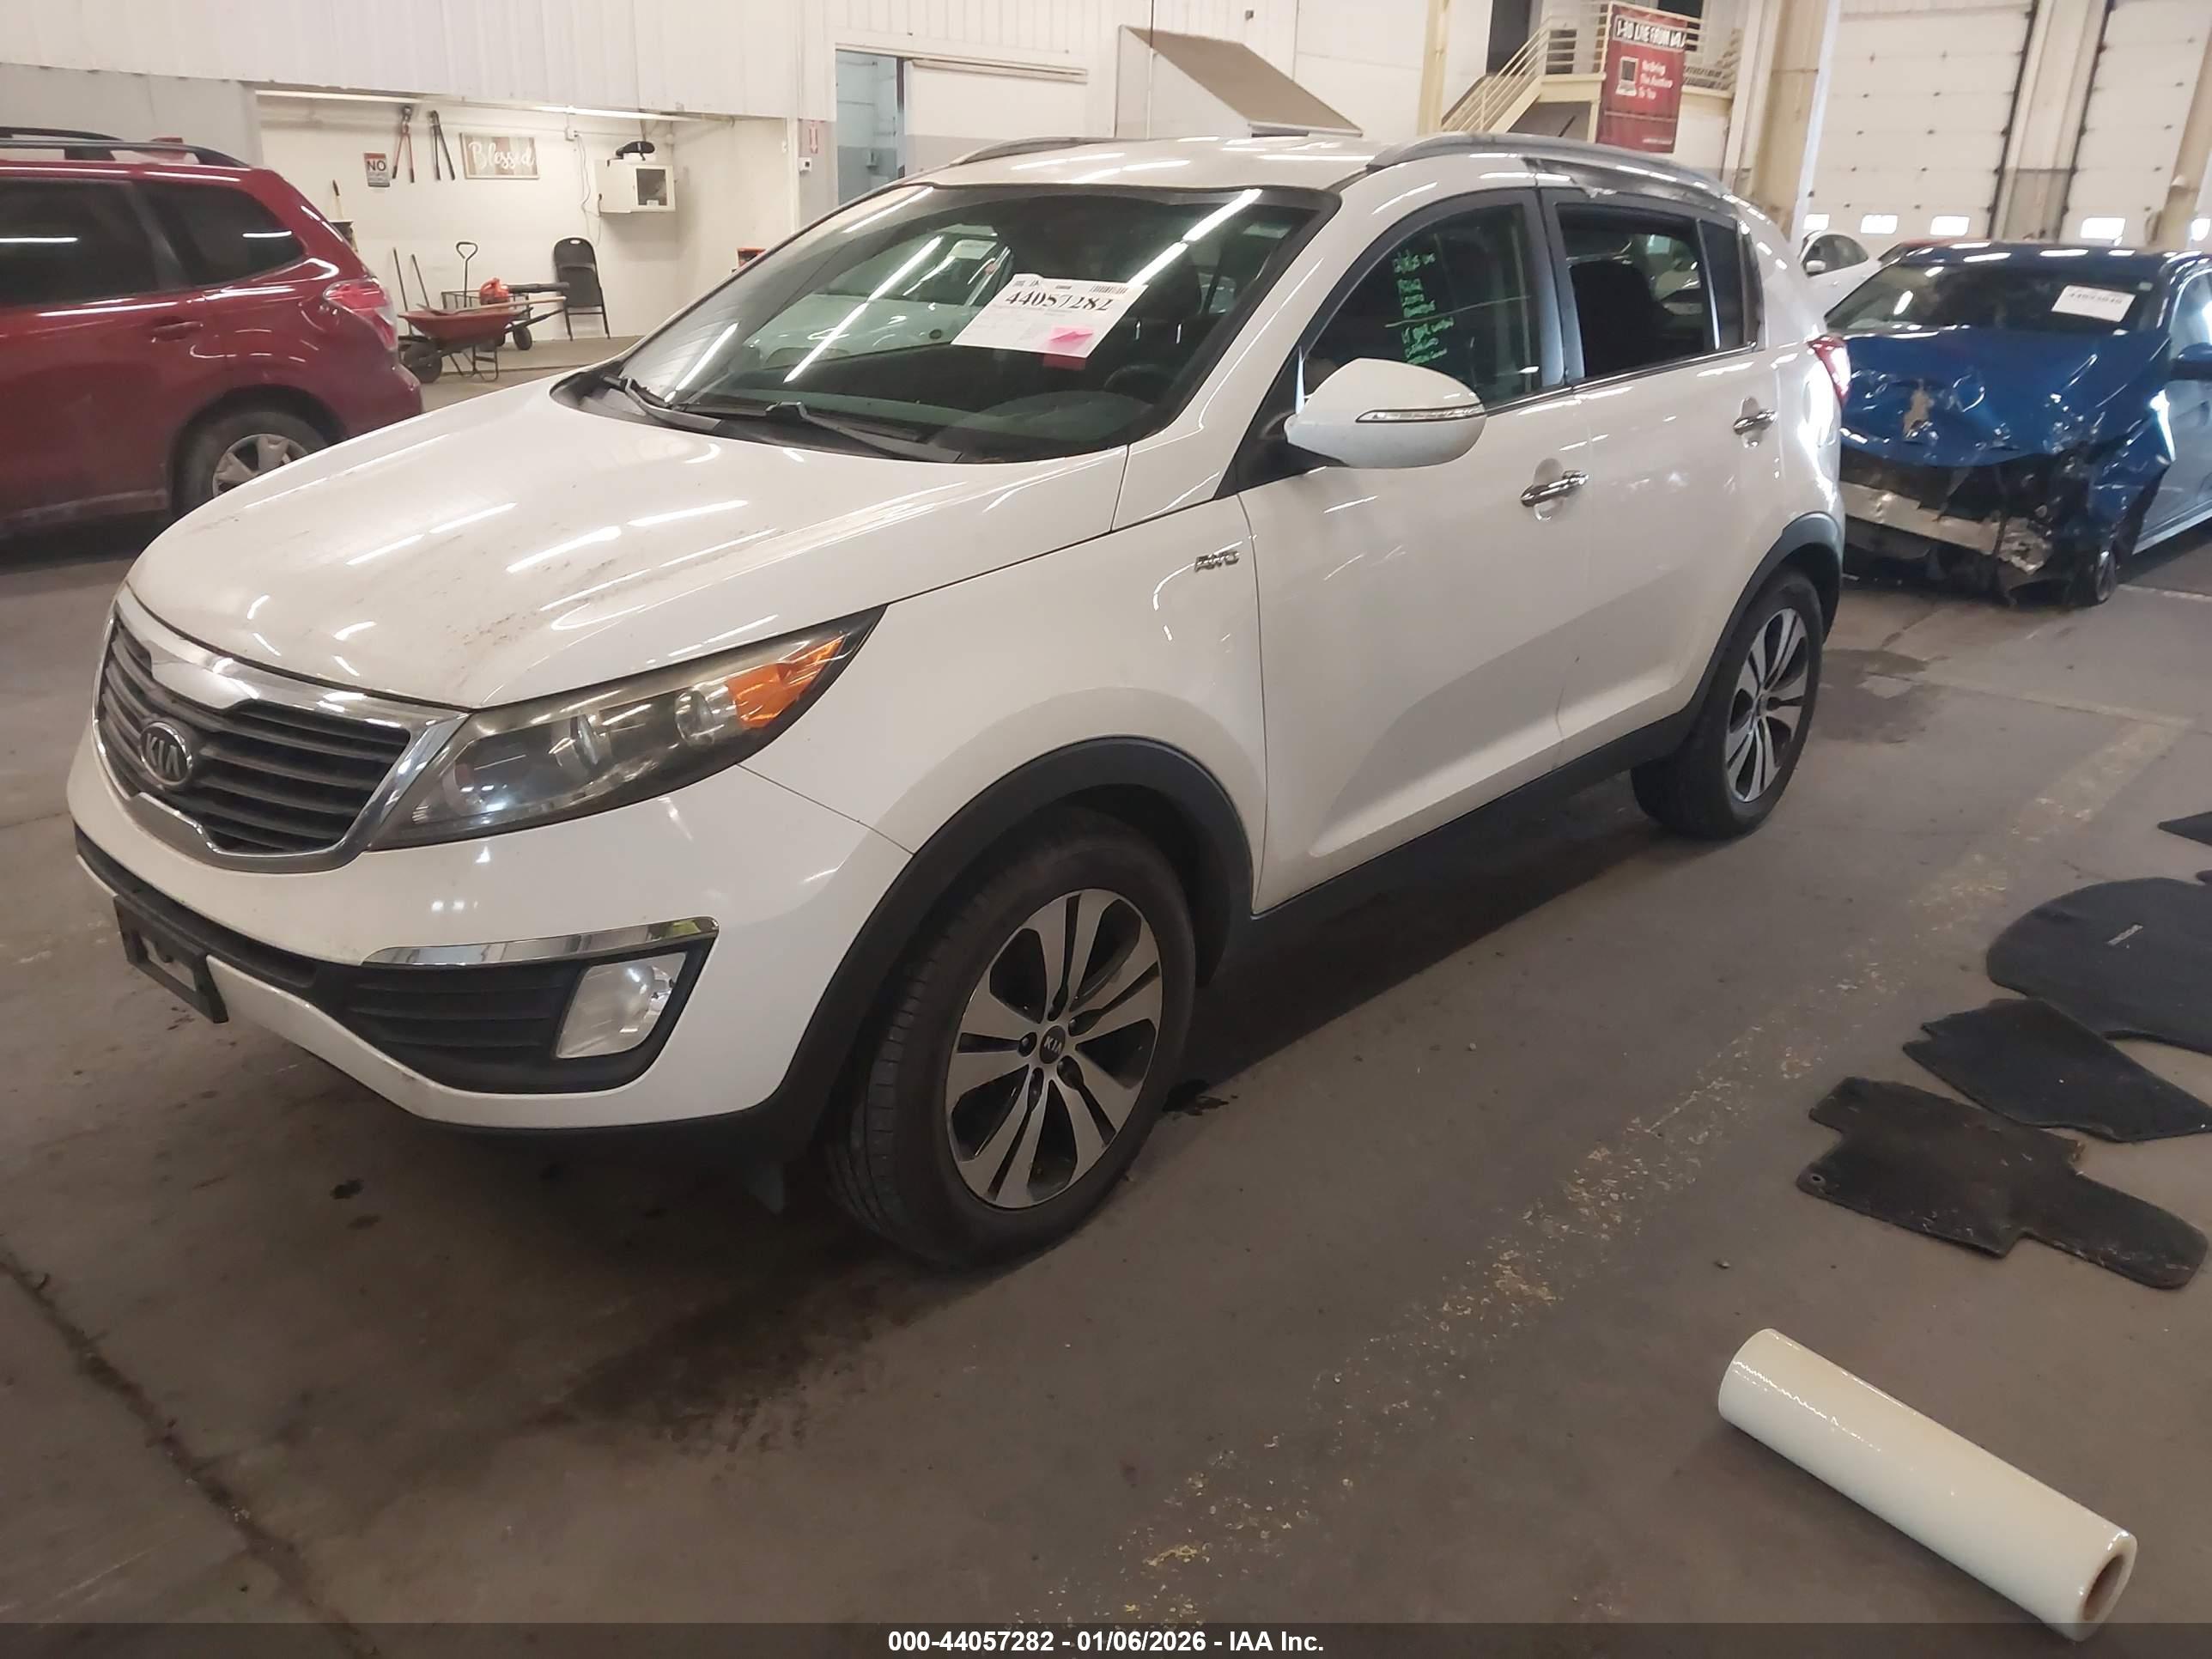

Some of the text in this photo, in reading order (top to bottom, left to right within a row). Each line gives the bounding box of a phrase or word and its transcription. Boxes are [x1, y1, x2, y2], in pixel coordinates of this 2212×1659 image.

[367, 159, 386, 172] NO
[468, 141, 536, 170] Blessed
[1006, 289, 1115, 312] 44057282
[1043, 1036, 1063, 1054] KIA
